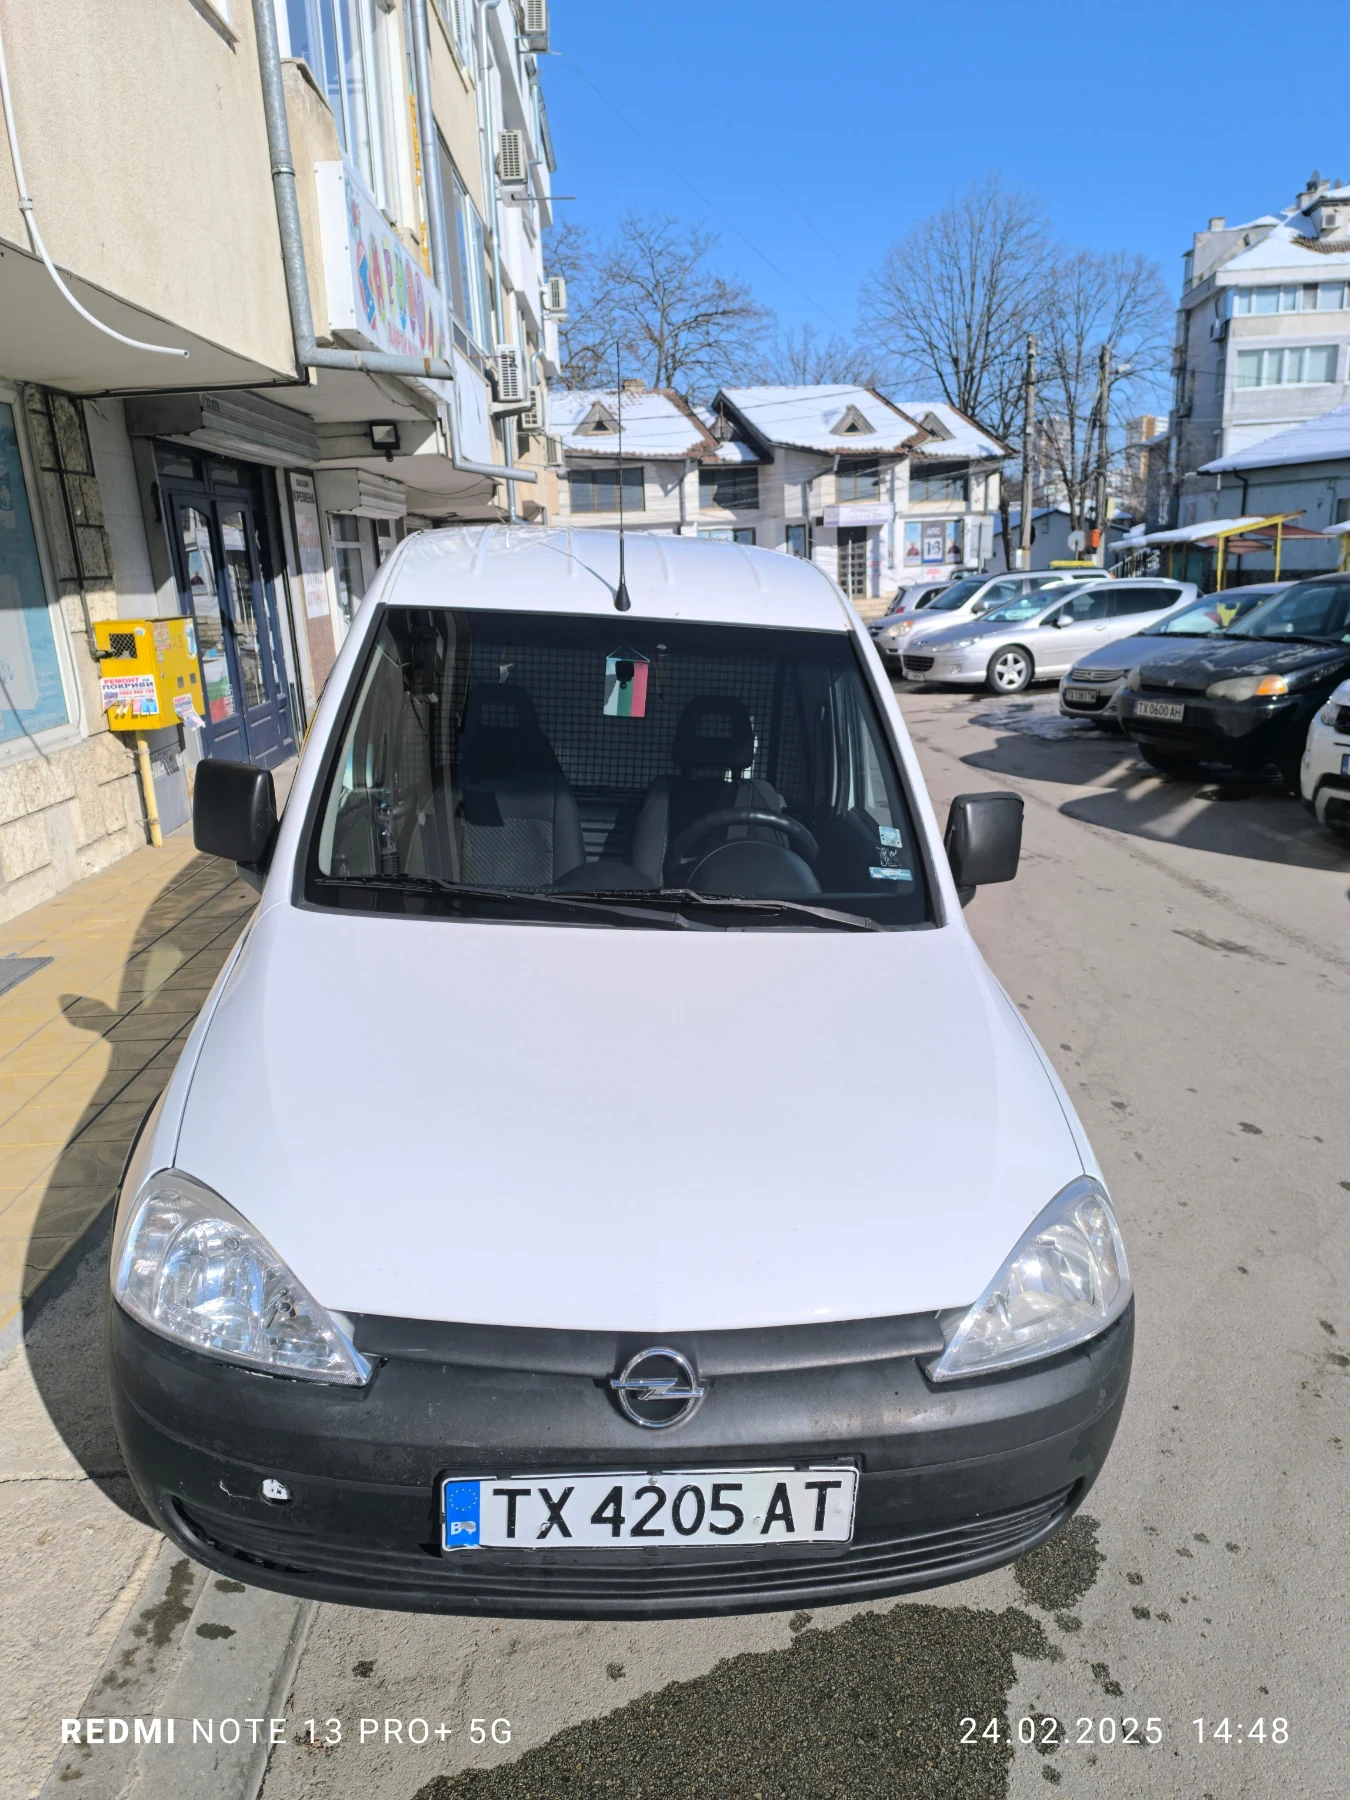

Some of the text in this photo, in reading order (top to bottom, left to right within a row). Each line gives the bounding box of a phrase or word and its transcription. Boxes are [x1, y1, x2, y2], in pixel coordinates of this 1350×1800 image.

[102, 681, 153, 690] ПОКРИВИ
[1139, 702, 1149, 714] TX
[1170, 706, 1181, 718] AH
[493, 1480, 842, 1540] TX 4205 AT
